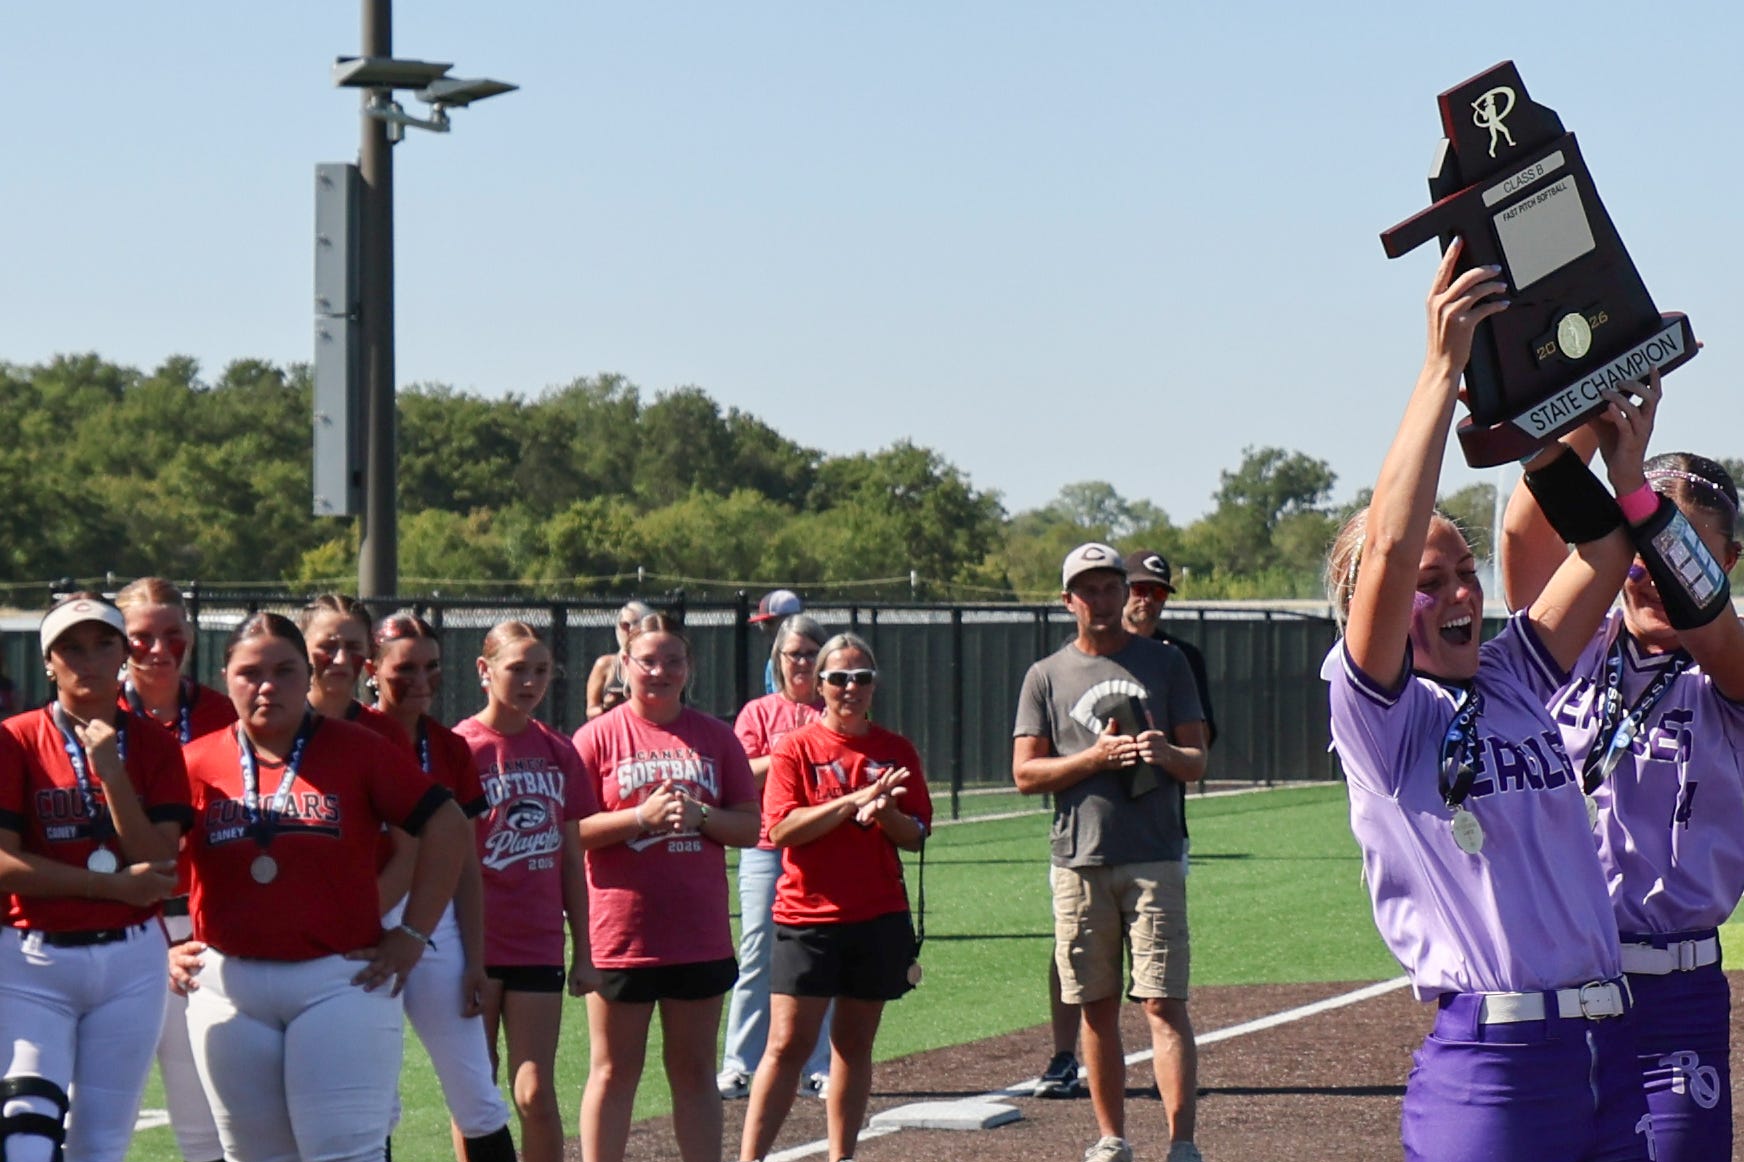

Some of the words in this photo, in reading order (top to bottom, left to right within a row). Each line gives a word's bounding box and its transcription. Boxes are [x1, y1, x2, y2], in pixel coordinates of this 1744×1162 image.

[1503, 167, 1536, 193] CLASS
[1535, 163, 1545, 176] B
[1502, 207, 1519, 223] FAST
[1519, 198, 1537, 214] PITCH
[1536, 182, 1568, 204] SOFTBALL
[1536, 340, 1557, 361] 20
[1589, 310, 1609, 329] 26
[1530, 390, 1583, 431] STATE
[1580, 333, 1679, 401] CHAMPION
[636, 748, 697, 761] CANEY
[616, 759, 719, 800] SOFTBALL
[210, 826, 245, 844] CANEY
